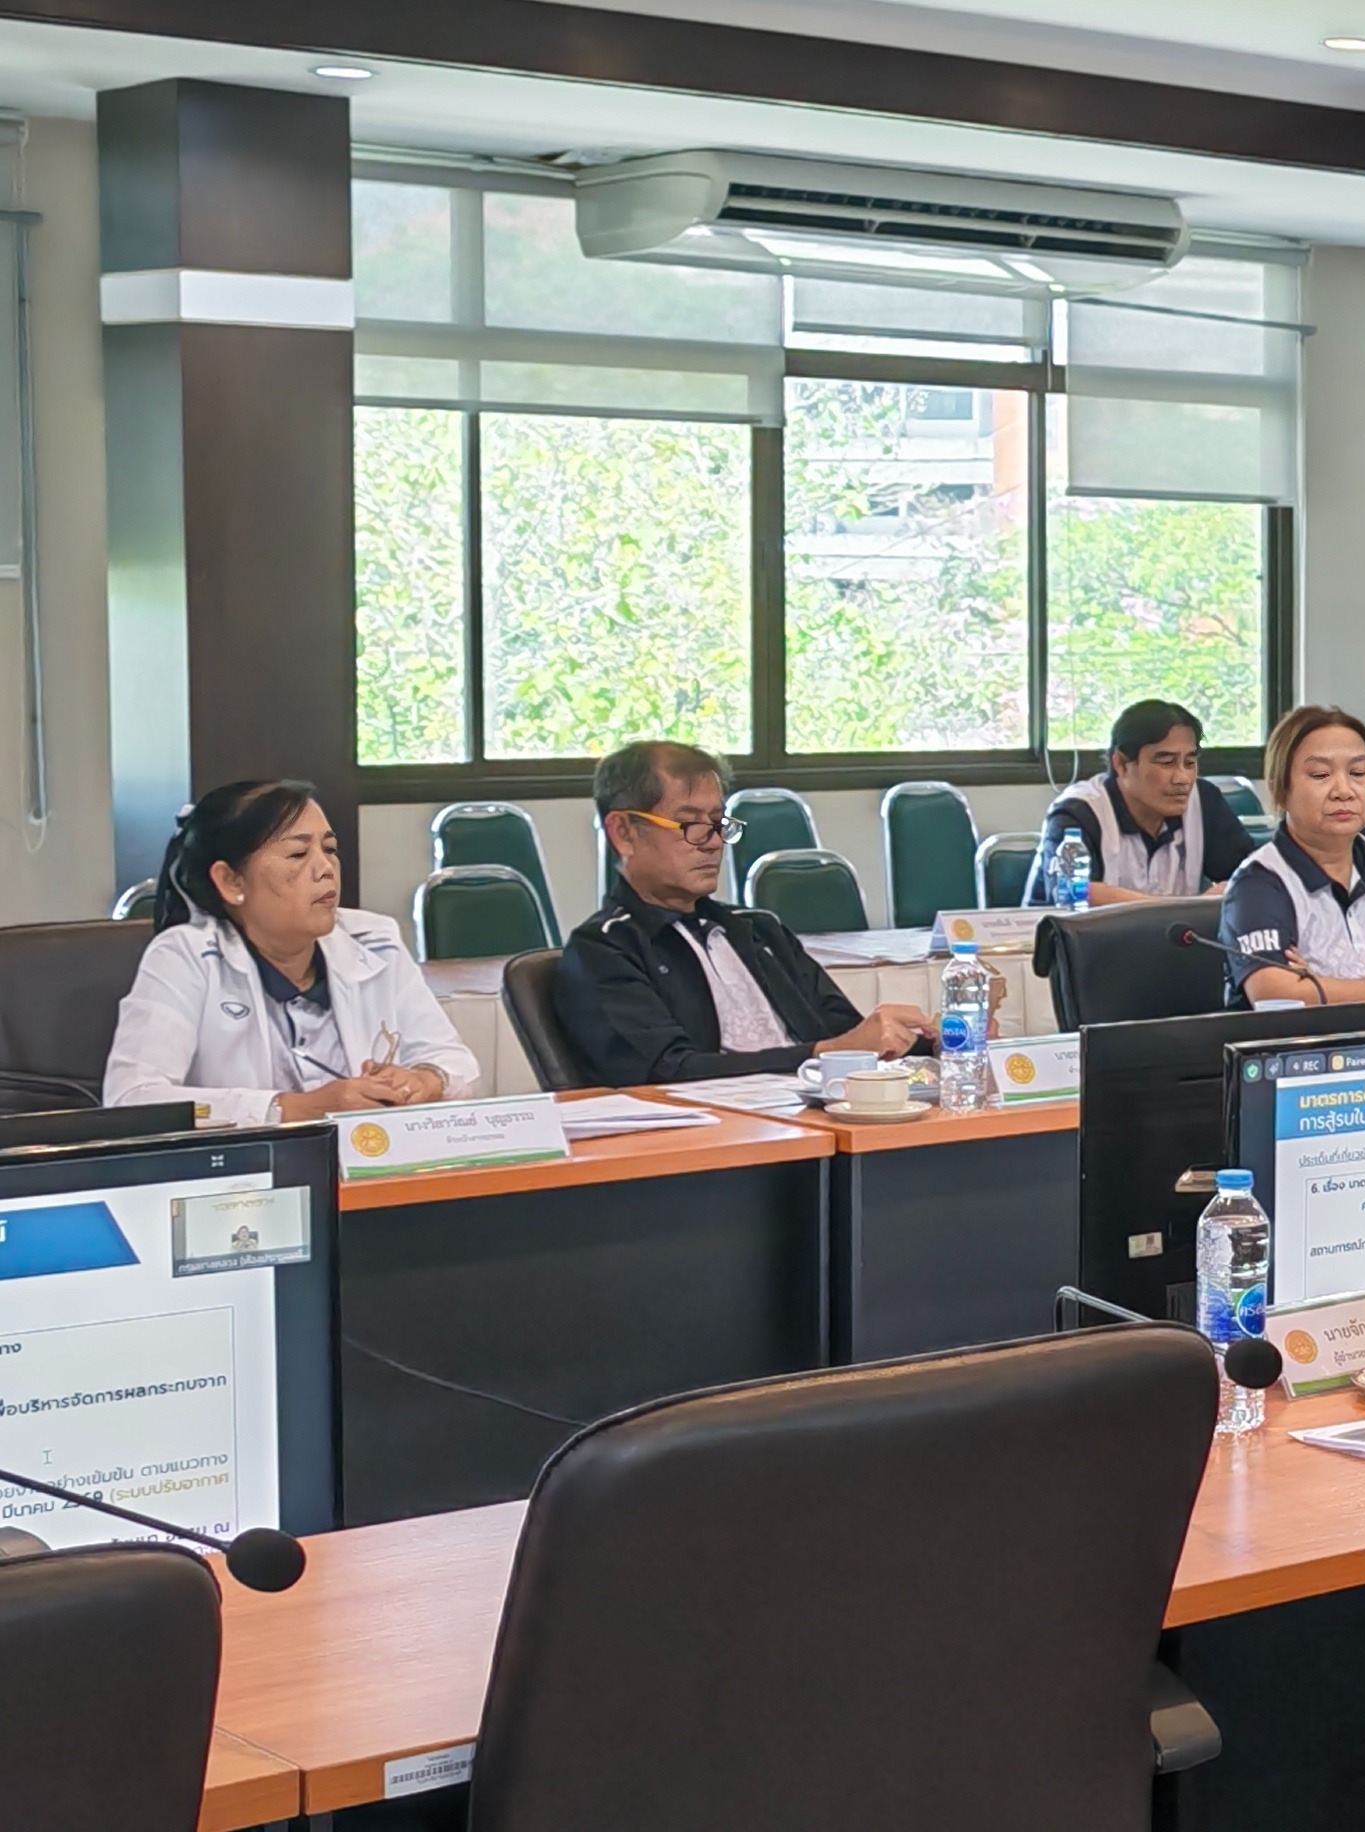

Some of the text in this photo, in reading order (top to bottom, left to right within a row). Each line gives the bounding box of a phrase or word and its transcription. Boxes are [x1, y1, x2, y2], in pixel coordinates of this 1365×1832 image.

[1236, 928, 1282, 955] DOH
[1303, 1059, 1321, 1072] REC
[140, 1452, 229, 1478] ตามแนวทาง
[1, 1499, 55, 1520] มีนาคม
[109, 1472, 230, 1505] (ระบบปรับอากาศ
